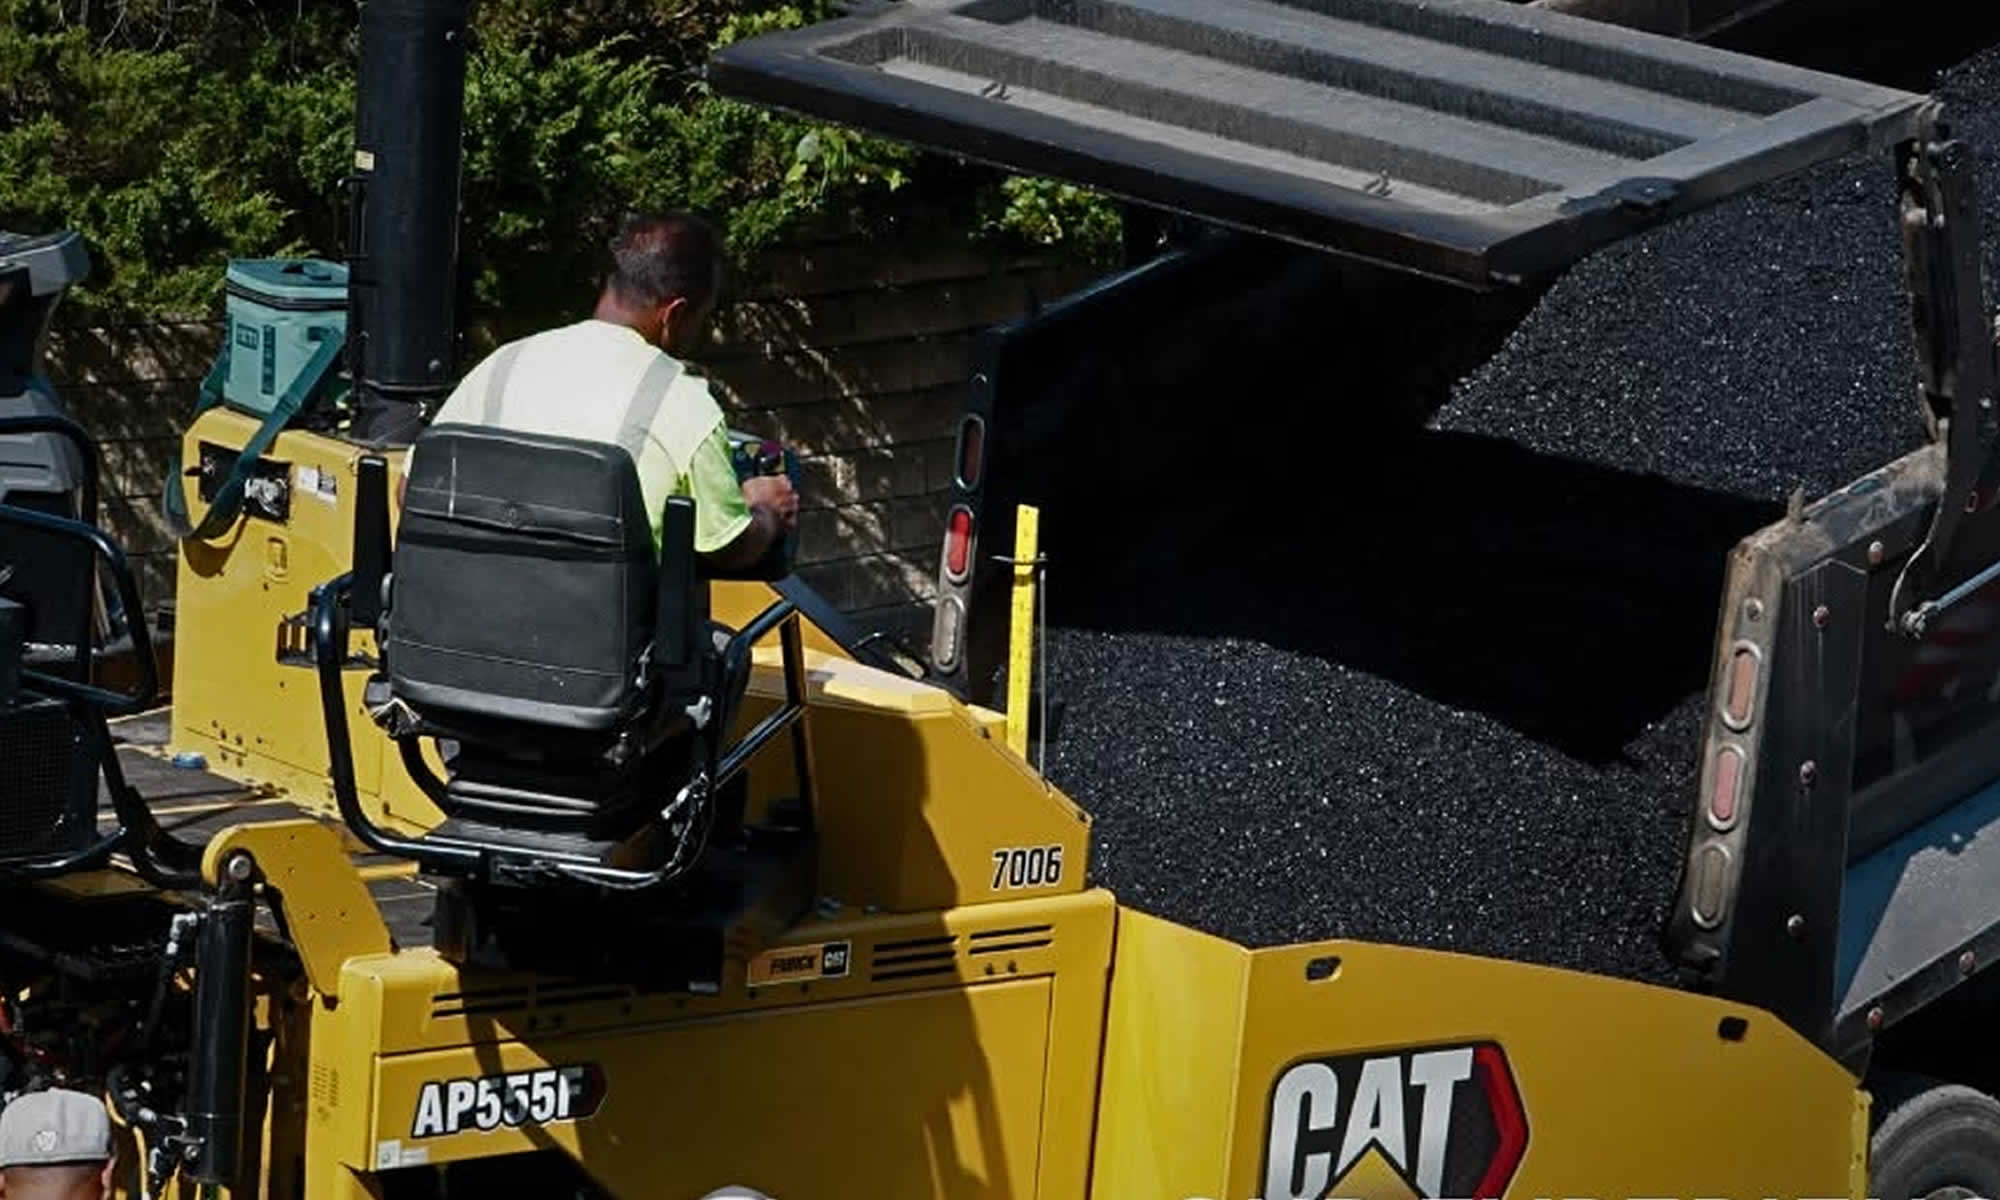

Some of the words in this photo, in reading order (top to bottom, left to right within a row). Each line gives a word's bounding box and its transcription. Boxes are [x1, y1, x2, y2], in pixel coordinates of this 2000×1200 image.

[992, 844, 1063, 891] 7006
[824, 950, 845, 969] CAT
[412, 1066, 585, 1138] AP555F
[1265, 1048, 1474, 1200] CAT
